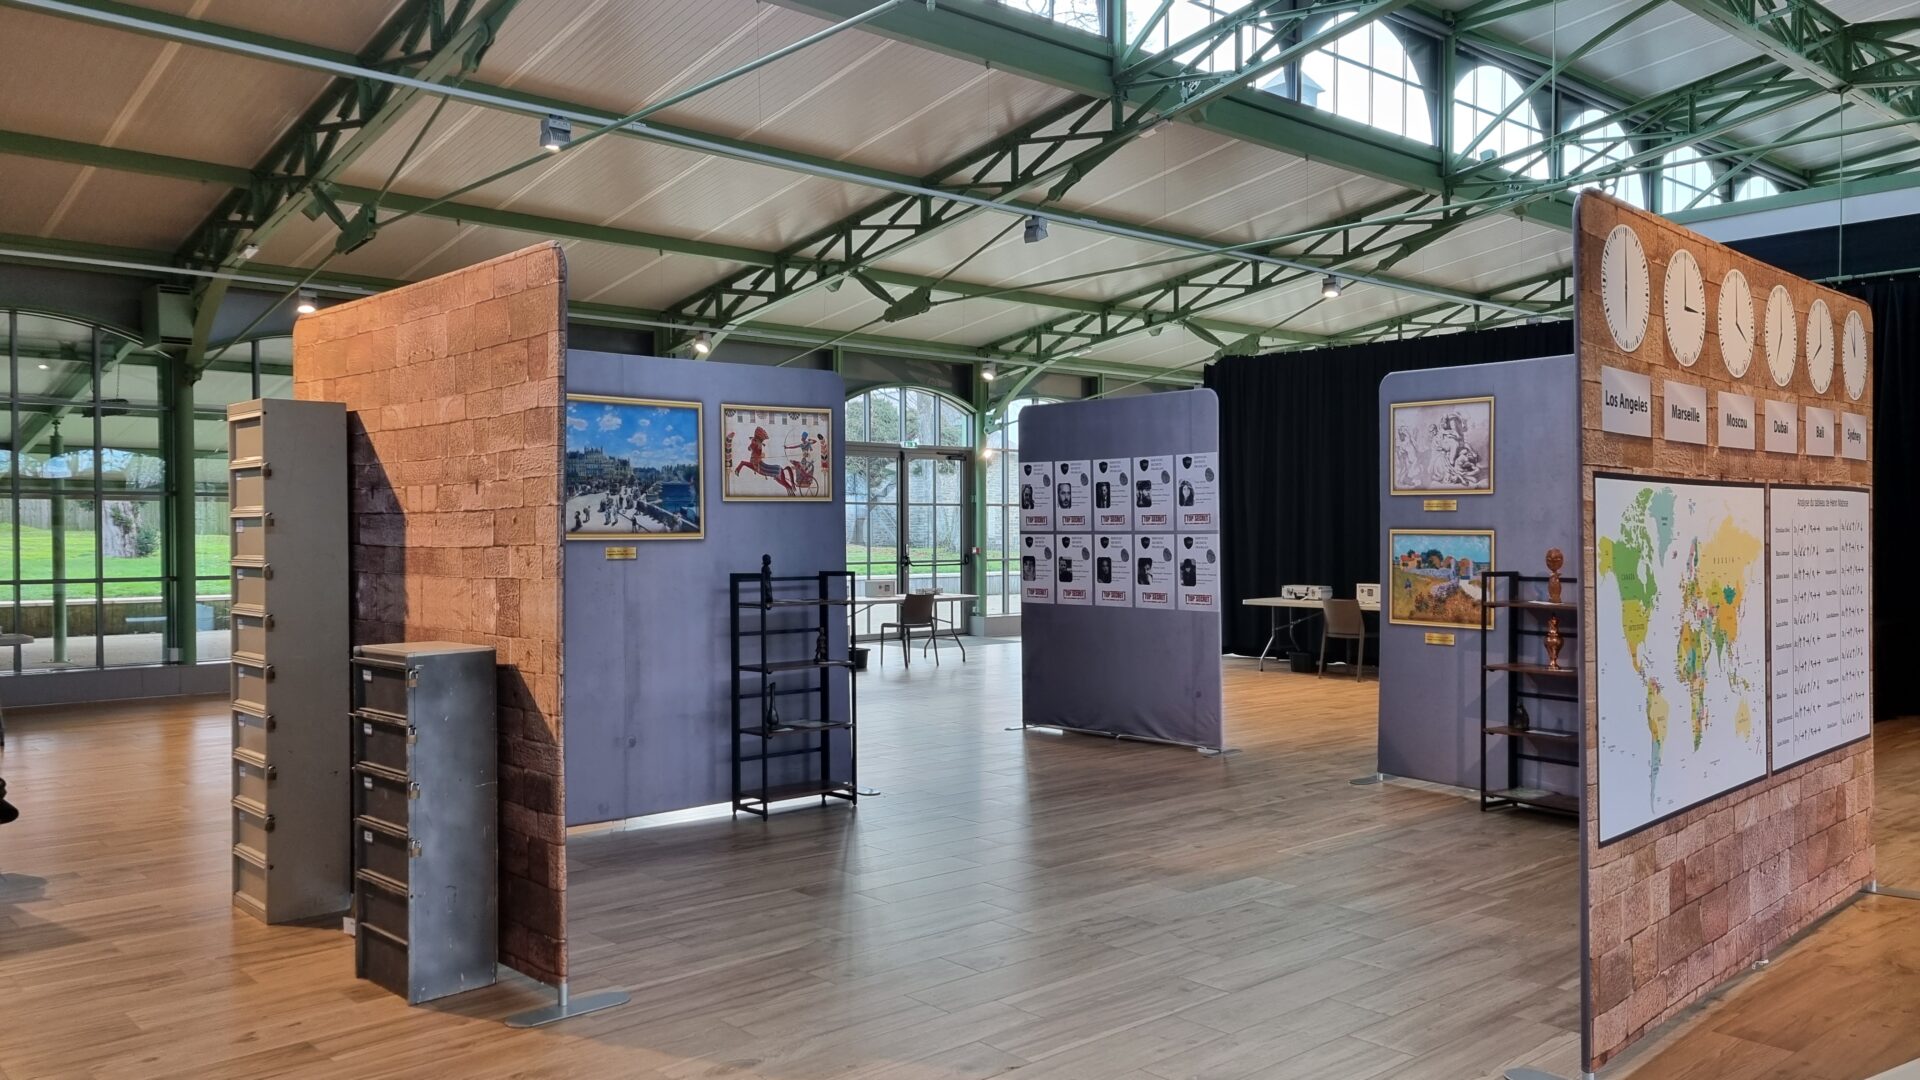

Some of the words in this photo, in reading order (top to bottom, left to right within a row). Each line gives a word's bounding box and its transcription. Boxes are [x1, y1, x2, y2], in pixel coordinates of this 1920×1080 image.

[1605, 390, 1618, 407] Los
[1619, 393, 1648, 414] Angeles
[1671, 404, 1700, 423] Marseille
[1726, 413, 1747, 429] Moscou
[1847, 429, 1861, 444] Sydney
